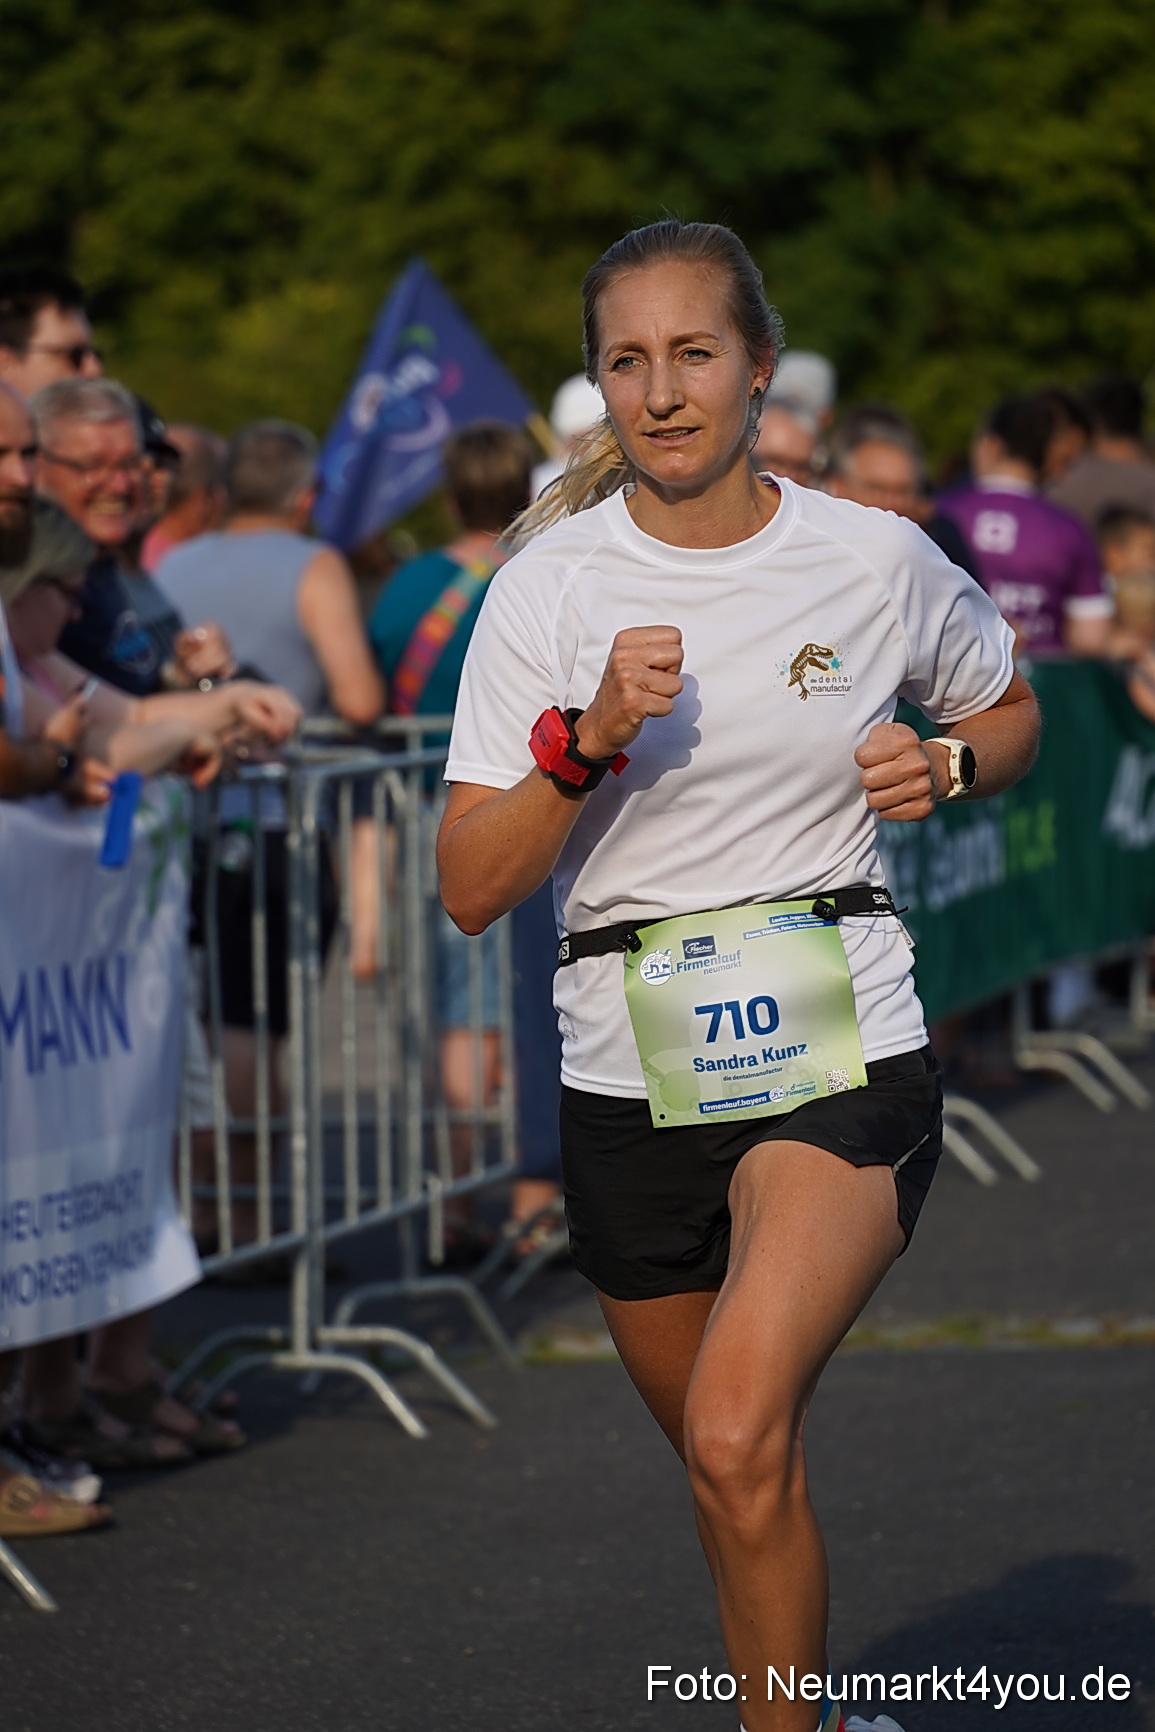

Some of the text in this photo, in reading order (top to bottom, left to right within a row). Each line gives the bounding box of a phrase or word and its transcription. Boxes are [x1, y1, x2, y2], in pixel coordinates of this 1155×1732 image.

[819, 675, 853, 683] dental
[810, 684, 852, 693] manufactur
[676, 950, 741, 974] Firmenlauf
[703, 960, 742, 975] neumarkt
[694, 995, 780, 1044] 710
[692, 1043, 808, 1073] Sandra Kunz
[732, 1066, 783, 1081] dentalmanufactur
[702, 1096, 768, 1113] firmenlauf.bayern
